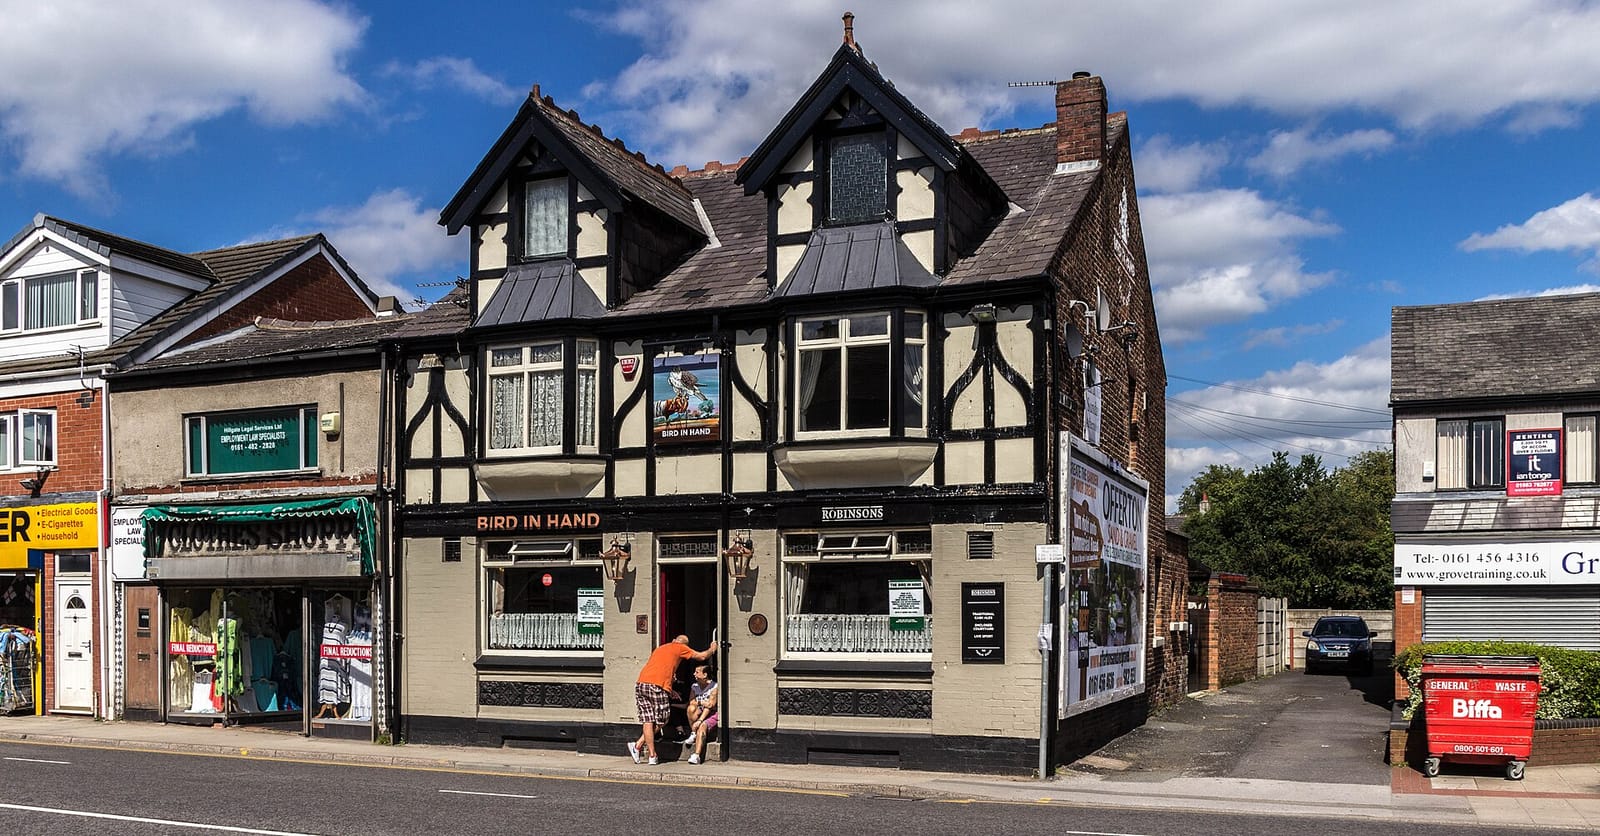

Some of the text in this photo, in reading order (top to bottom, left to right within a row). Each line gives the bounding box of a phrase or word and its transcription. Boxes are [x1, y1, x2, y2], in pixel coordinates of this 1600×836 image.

[689, 428, 711, 436] HAND
[221, 434, 249, 444] EMPLOYMENT
[259, 432, 286, 440] SPECIALISTS
[1102, 480, 1142, 533] OFFERTON
[41, 507, 97, 517] Electrical Goods
[822, 509, 884, 520] ROBINSONS
[41, 520, 83, 529] E-Cigarettes
[477, 513, 600, 531] BIRD IN HAND
[41, 532, 78, 540] Household
[169, 521, 260, 551] CLOTHES
[1442, 554, 1470, 563] 0161
[1476, 553, 1502, 563] 456
[1506, 553, 1539, 562] 4316
[1562, 551, 1600, 574] Gr
[1407, 568, 1547, 581] www.grovetraining.co.uk
[172, 644, 215, 653] FINAL REDUCTIONS
[323, 646, 372, 656] FINAL REDUCTIONS
[1430, 682, 1526, 691] GENERAL WASTE
[1453, 699, 1502, 719] Biffa
[1454, 745, 1503, 753] 0800-601-601
